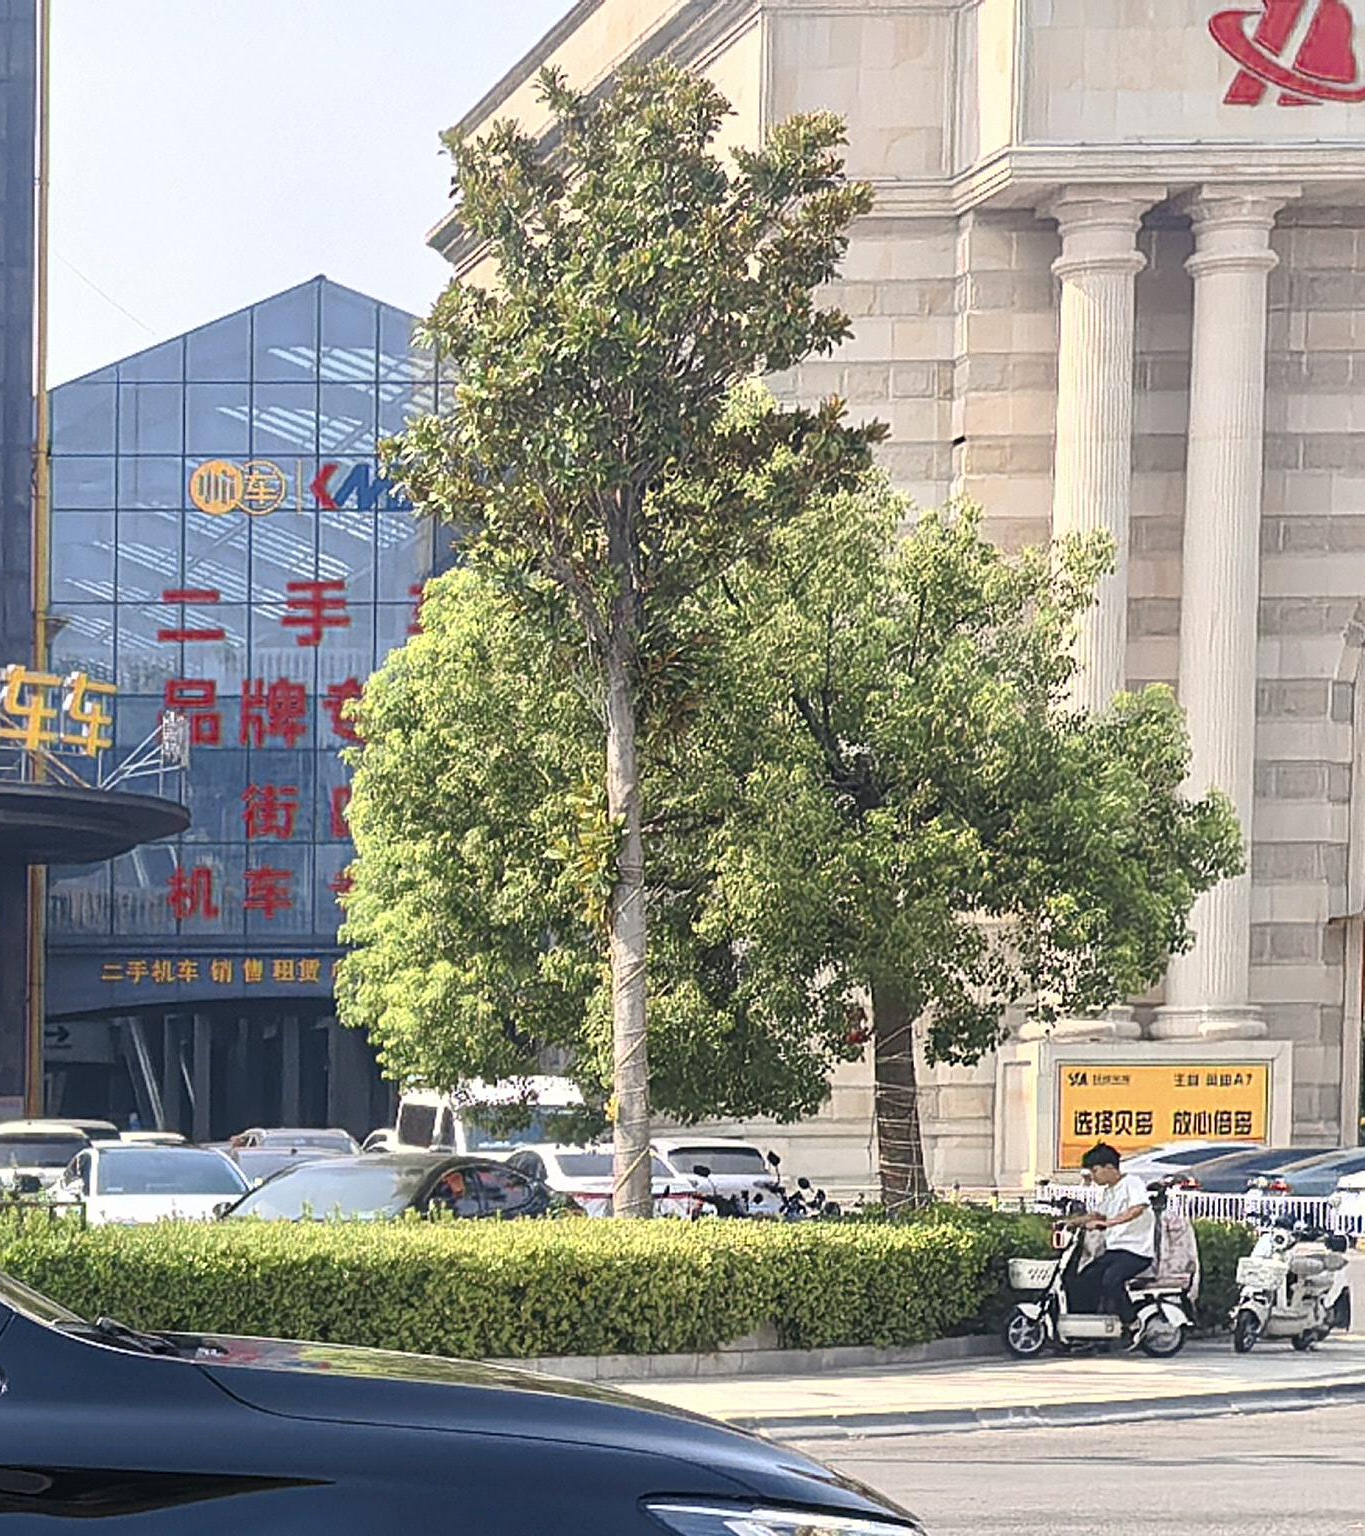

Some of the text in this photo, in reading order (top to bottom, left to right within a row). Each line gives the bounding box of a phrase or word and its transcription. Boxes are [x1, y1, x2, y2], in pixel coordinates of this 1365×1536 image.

[1074, 1110, 1253, 1136] 选择贝多 放心倍多
